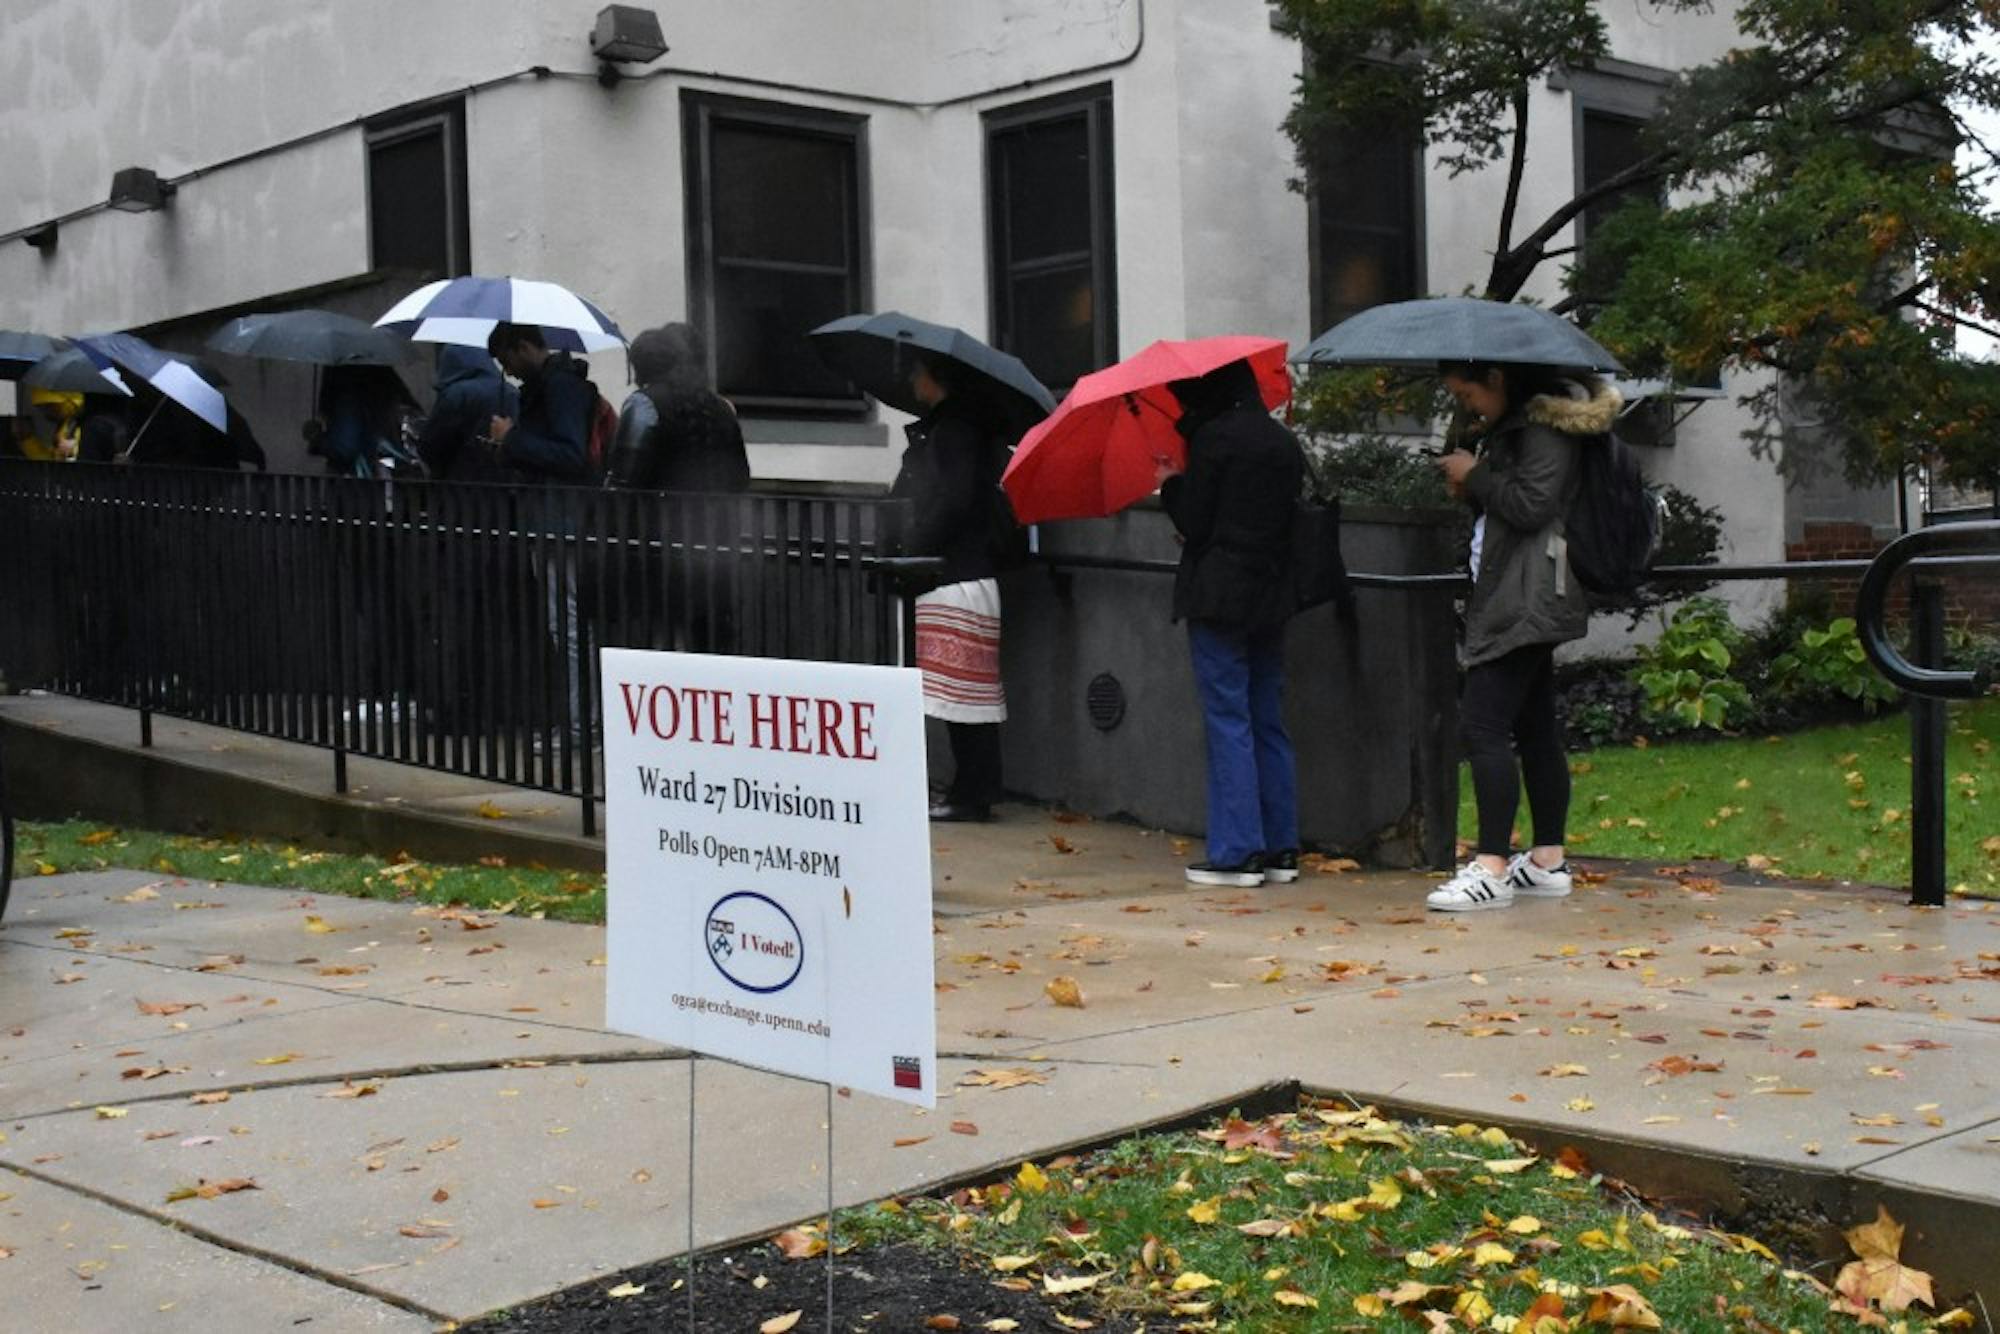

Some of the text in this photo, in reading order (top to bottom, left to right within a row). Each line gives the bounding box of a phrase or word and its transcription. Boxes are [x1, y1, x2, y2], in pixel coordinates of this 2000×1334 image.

[618, 683, 878, 761] VOTE HERE
[637, 765, 863, 824] Ward 27 Division 11
[658, 828, 841, 879] Polls Open 7AM-8PM
[741, 932, 795, 959] I Voted!
[671, 992, 832, 1038] ogra@exchange.upenn.edu
